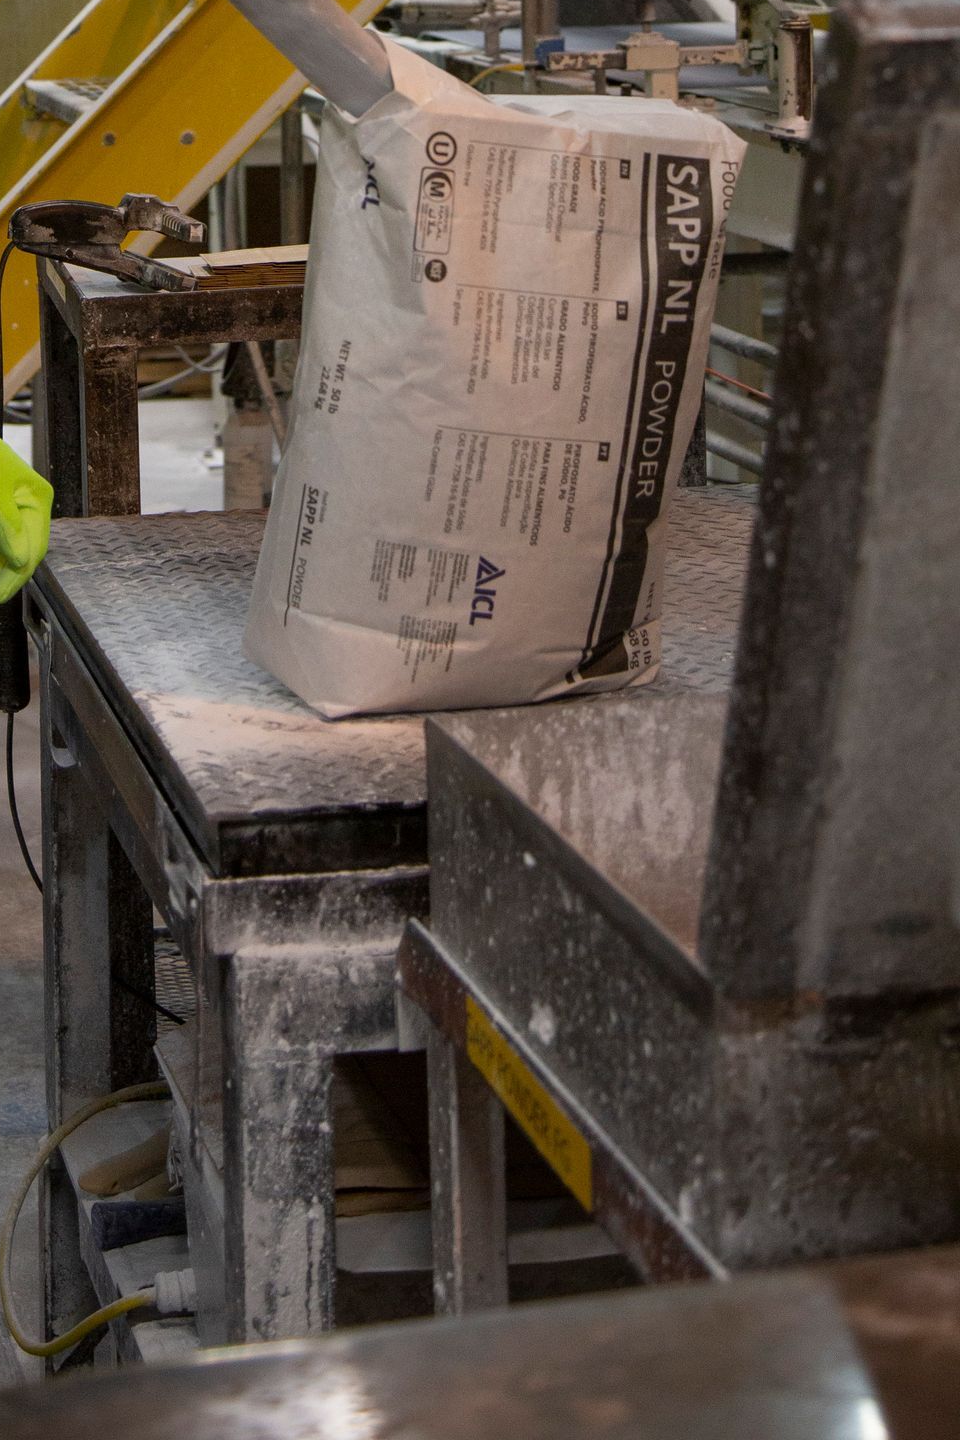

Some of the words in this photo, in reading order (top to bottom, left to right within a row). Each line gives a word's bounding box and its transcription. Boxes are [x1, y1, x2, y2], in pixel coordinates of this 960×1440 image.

[465, 143, 474, 169] Gluten
[487, 146, 496, 162] CAS
[497, 147, 507, 176] Sodium
[550, 153, 558, 179] Codex
[560, 155, 569, 180] Meets
[571, 156, 580, 182] FOOD
[430, 181, 445, 197] M
[495, 178, 503, 195] Acid
[558, 182, 567, 203] Food
[568, 183, 579, 213] GRADE
[544, 181, 556, 233] Specification
[665, 161, 699, 267] SAPP
[554, 204, 564, 243] Chemical
[476, 290, 484, 305] CAS
[659, 278, 692, 336] NL
[452, 301, 461, 326] gluten
[546, 297, 556, 329] Cumple
[559, 299, 569, 331] GRADO
[581, 301, 590, 326] Polvo
[590, 302, 598, 331] SODIO
[337, 339, 351, 361] NET
[544, 331, 552, 347] con
[333, 363, 347, 382] WT.
[521, 339, 531, 382] Sustancias
[551, 332, 565, 391] ALIMENTICIO
[582, 332, 597, 392] PIROFOSFATO
[318, 365, 331, 395] 22.68
[313, 396, 325, 410] kg
[329, 387, 341, 401] 50
[327, 403, 338, 414] lb
[457, 432, 466, 447] CAS
[634, 358, 675, 501] POWDER
[542, 441, 551, 464] PARA
[564, 443, 572, 454] DE
[518, 452, 527, 477] Codex
[538, 466, 548, 485] FINS
[567, 443, 582, 503] PIROFOSFATO
[514, 479, 522, 498] para
[303, 486, 319, 524] SAPP
[562, 504, 574, 533] ÁCIDO
[299, 526, 313, 547] NL
[290, 556, 307, 609] POWDER
[640, 629, 648, 646] 50
[628, 650, 640, 670] kg
[643, 649, 650, 664] lb
